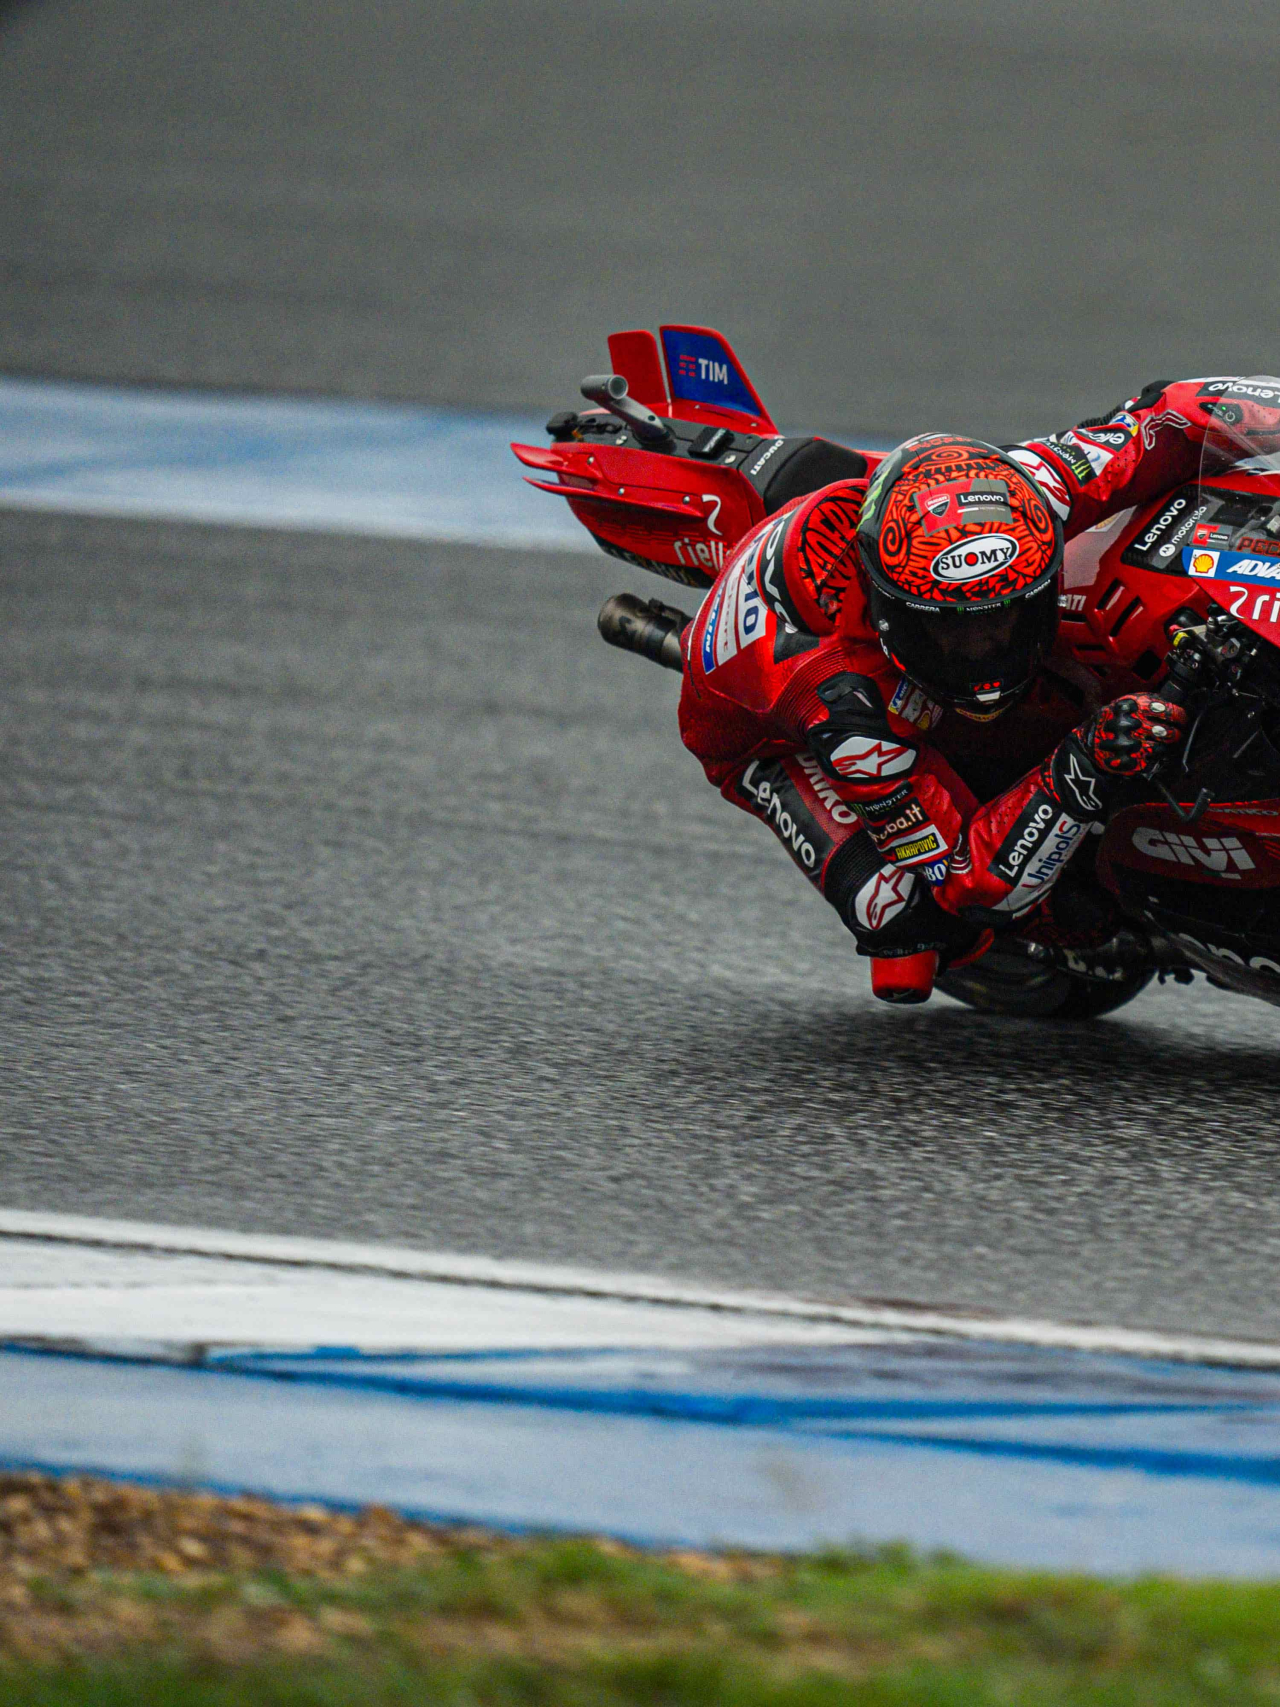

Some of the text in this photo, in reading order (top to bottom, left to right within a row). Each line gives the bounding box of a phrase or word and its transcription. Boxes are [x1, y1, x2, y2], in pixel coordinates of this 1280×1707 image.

[698, 357, 728, 385] TIM
[750, 439, 784, 476] DUCATI
[960, 494, 1004, 503] Lenovo
[1134, 498, 1188, 551] Lenovo
[672, 538, 730, 572] riell
[940, 547, 1011, 571] SUOMY
[741, 760, 816, 869] Lenovo
[870, 802, 924, 844] ruba.it
[998, 803, 1053, 878] Lenovo
